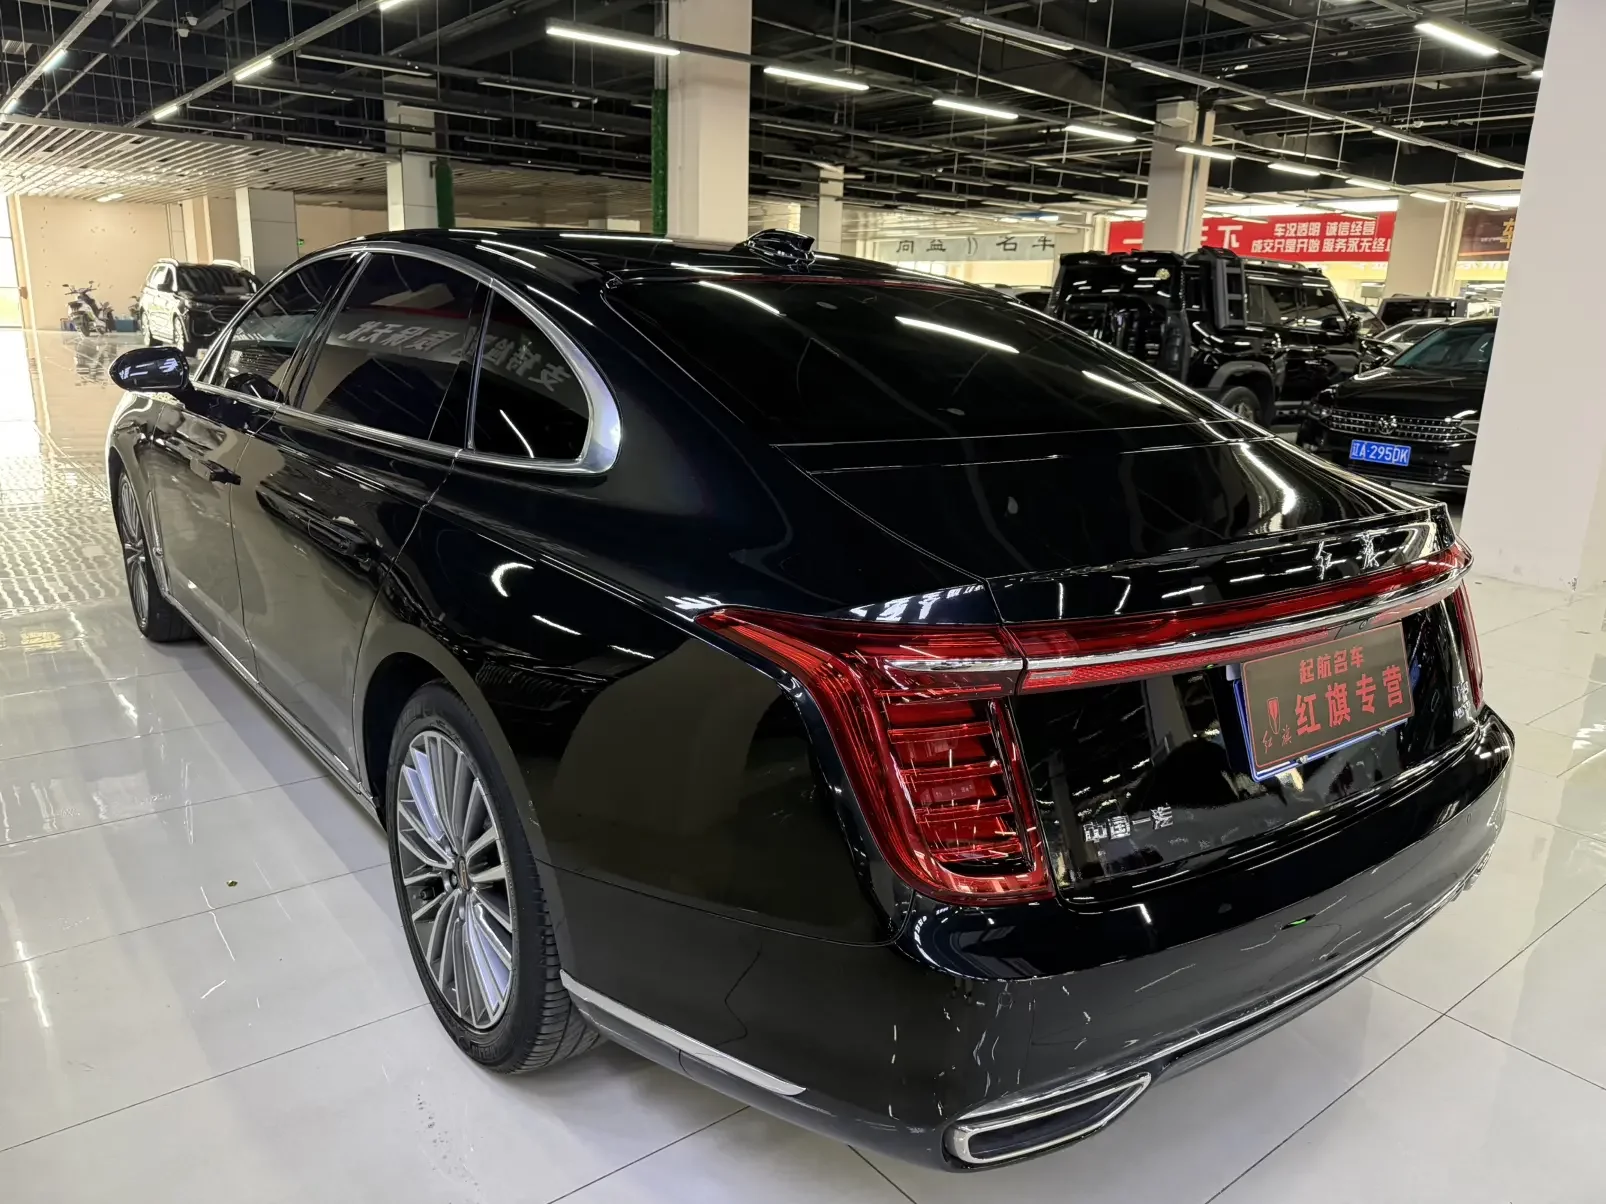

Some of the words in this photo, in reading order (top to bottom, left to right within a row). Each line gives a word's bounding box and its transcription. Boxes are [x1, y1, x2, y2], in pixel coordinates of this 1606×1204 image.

[1325, 221, 1376, 236] 诚信经营
[1251, 239, 1320, 253] 成交只是开始
[1299, 646, 1365, 685] 起航名车
[1294, 664, 1404, 736] 红旗专营
